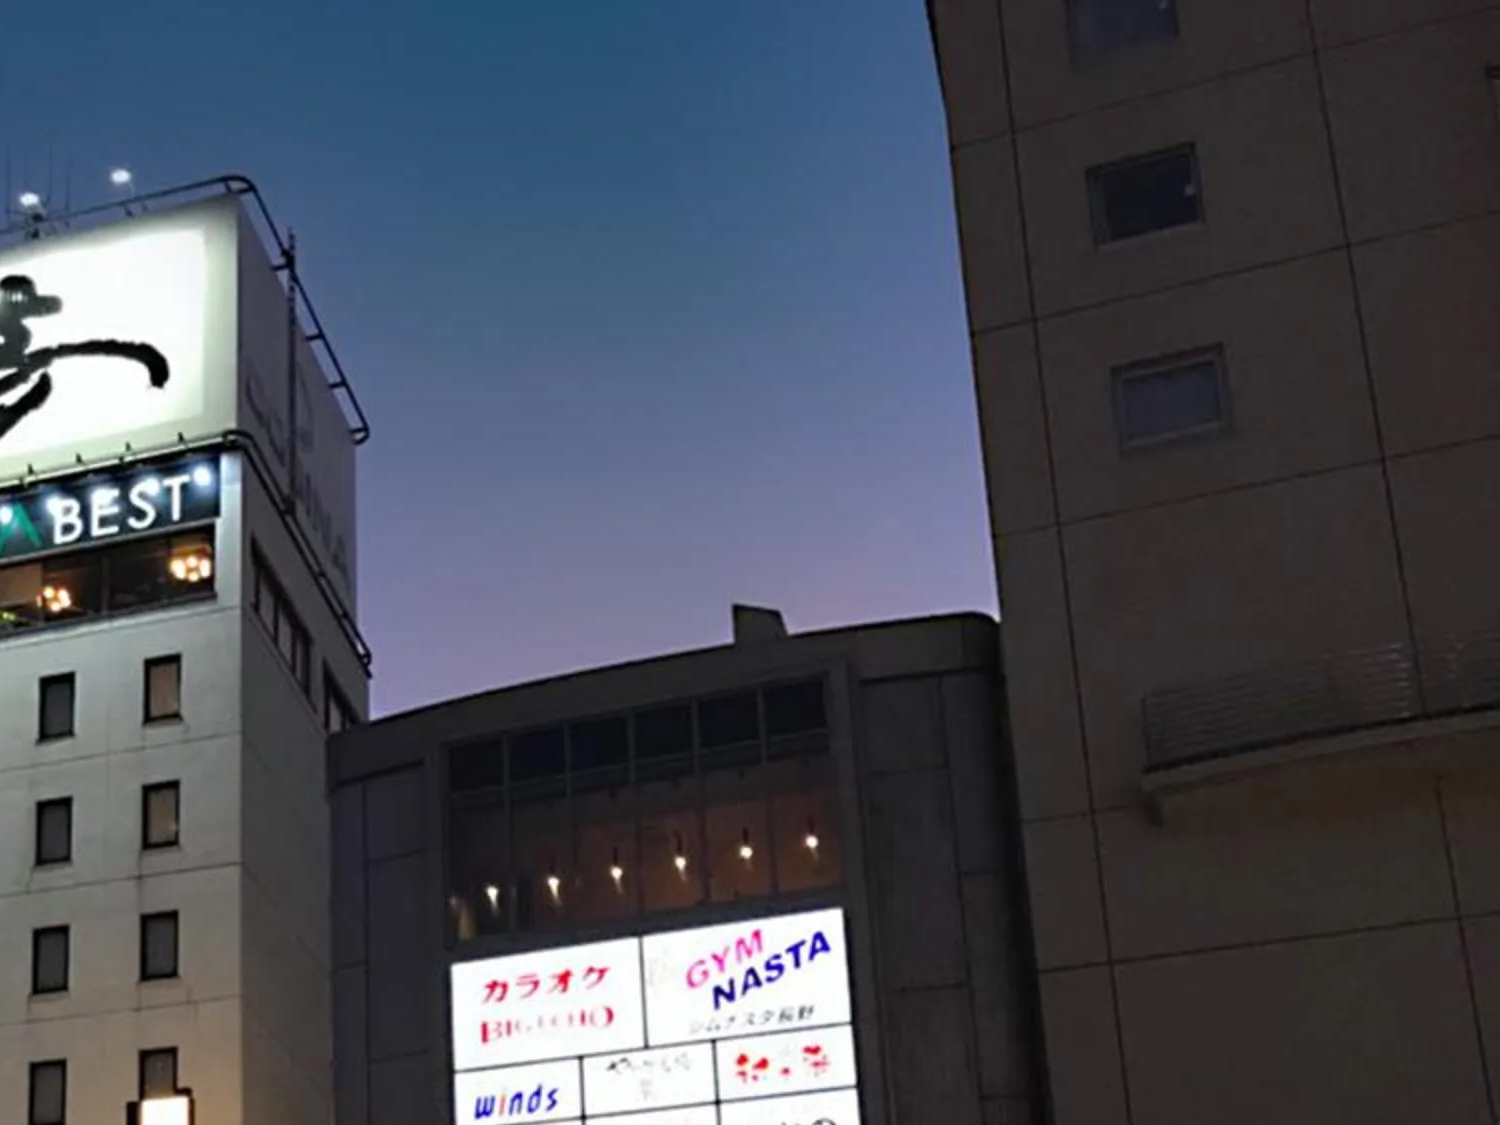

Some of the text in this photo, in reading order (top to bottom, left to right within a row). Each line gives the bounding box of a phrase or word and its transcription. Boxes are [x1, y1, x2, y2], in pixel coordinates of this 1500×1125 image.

[685, 929, 765, 989] GYM
[711, 930, 832, 1011] NASTA
[483, 965, 611, 1005] カラオケ
[473, 1084, 560, 1119] winds
